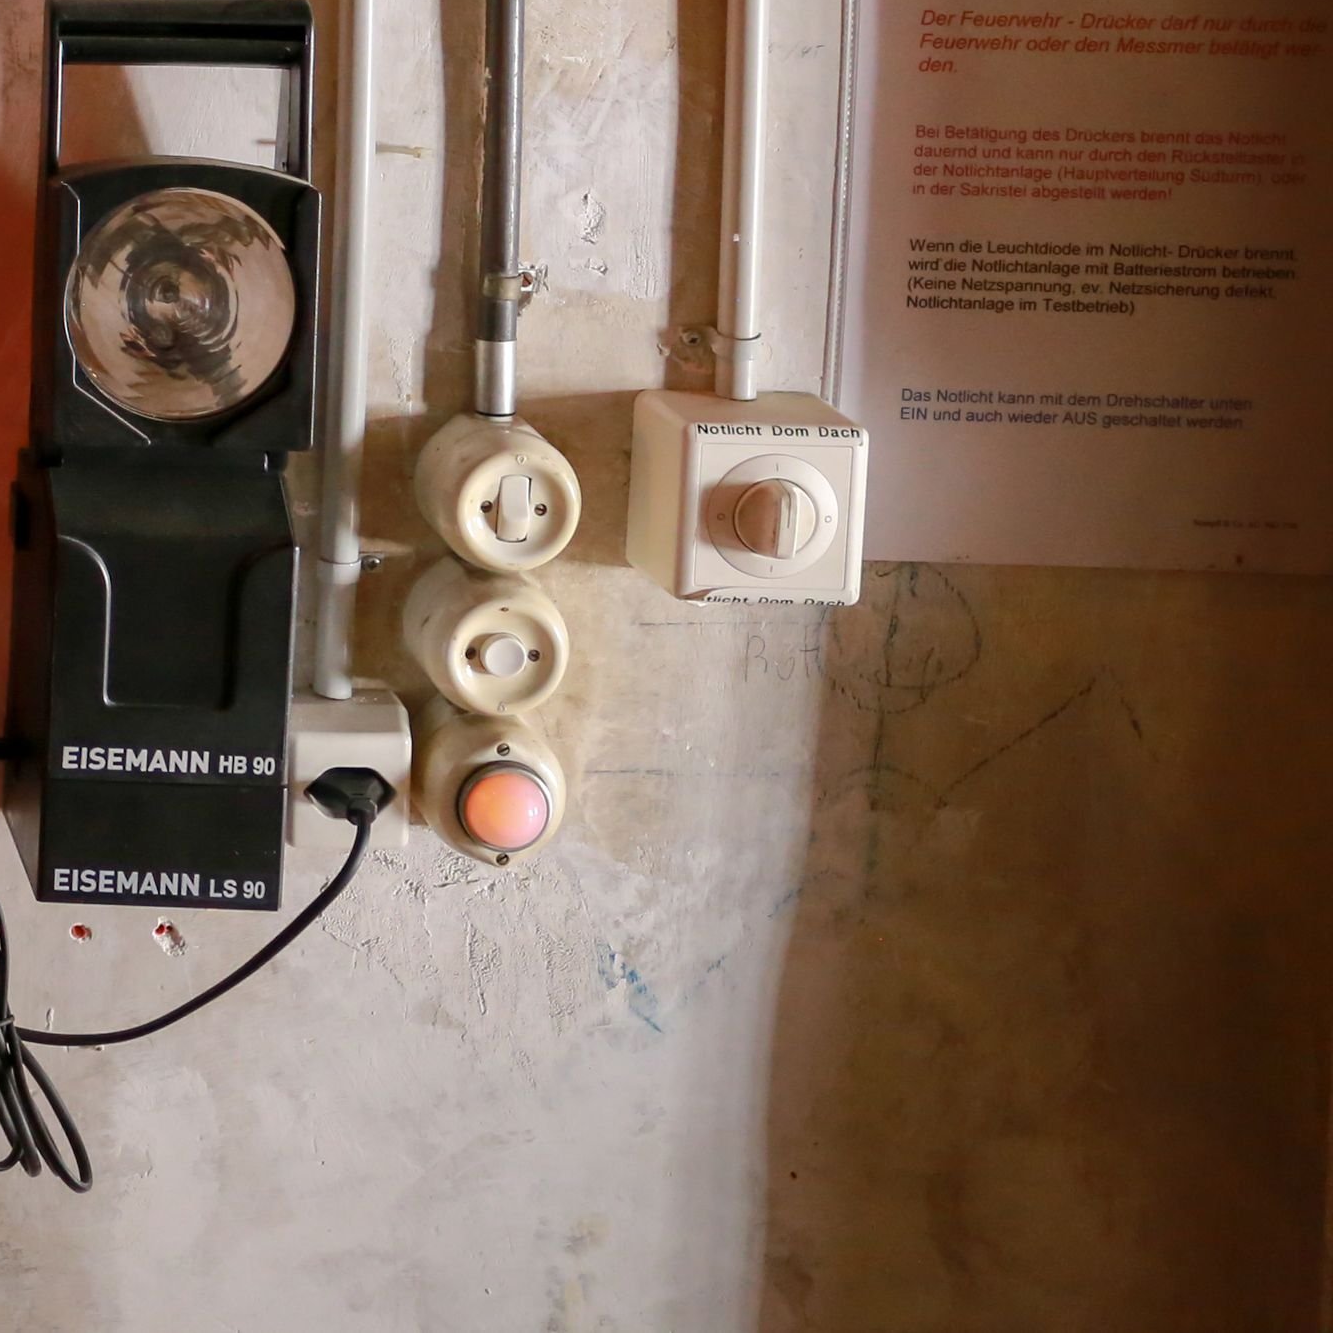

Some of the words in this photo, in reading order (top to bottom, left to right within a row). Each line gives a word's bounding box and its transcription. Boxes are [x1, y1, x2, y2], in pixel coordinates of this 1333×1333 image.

[921, 9, 957, 26] Der
[961, 11, 1062, 28] Feuerwehr
[1081, 12, 1154, 30] Drücker
[1161, 15, 1202, 31] darf
[1203, 19, 1233, 31] nur
[1238, 17, 1293, 33] durch
[920, 34, 1018, 51] Feuerwehr
[1027, 35, 1069, 52] oder
[1075, 36, 1109, 53] den
[1117, 37, 1205, 53] Messmer
[1208, 38, 1280, 59] betätigt
[919, 57, 957, 73] den.
[916, 125, 939, 139] Bei
[945, 126, 1027, 143] Betätigung
[1032, 129, 1061, 141] des
[1065, 128, 1135, 144] Drückers
[1140, 131, 1189, 144] brennt
[1195, 132, 1223, 144] das
[913, 145, 977, 158] dauernd
[982, 146, 1011, 159] und
[1016, 147, 1053, 160] kann
[1059, 149, 1083, 161] nur
[1088, 148, 1132, 162] durch
[1137, 150, 1166, 163] den
[913, 164, 938, 177] der
[943, 164, 1052, 182] Notlichtanlage
[1057, 166, 1184, 185] (Hauptverteilung
[930, 182, 955, 196] der
[959, 182, 1027, 197] Sakristei
[1031, 185, 1106, 202] abgestellt
[1110, 187, 1172, 201] werden!
[910, 238, 955, 253] Wenn
[959, 239, 983, 254] die
[987, 240, 1081, 256] Leuchtdiode
[1086, 243, 1104, 257] im
[1109, 243, 1173, 259] Notlicht-
[1178, 244, 1239, 259] Drücker
[909, 258, 938, 272] wird
[943, 258, 967, 273] die
[972, 260, 1081, 279] Notlichtanlage
[1085, 261, 1109, 276] mit
[1113, 262, 1216, 278] Batteriestrom
[907, 276, 957, 293] (Keine
[961, 278, 1076, 297] Netzspannung,
[1108, 281, 1220, 300] Netzsicherung
[906, 295, 1014, 312] Notlichtanlage
[1019, 297, 1037, 311] im
[1042, 298, 1135, 316] Testbetrieb)
[901, 387, 931, 402] Das
[936, 388, 994, 404] Notlicht
[998, 391, 1034, 405] kann
[1040, 392, 1063, 406] mit
[1067, 392, 1101, 407] dem
[1107, 393, 1204, 410] Drehschalter
[1209, 397, 1252, 411] unten
[900, 407, 927, 420] EIN
[933, 407, 961, 422] und
[965, 409, 1003, 423] auch
[1008, 410, 1058, 425] wieder
[1062, 411, 1097, 426] AUS
[1102, 412, 1181, 429] geschaltet
[697, 423, 762, 436] Notlicht
[772, 425, 809, 437] Dom
[818, 426, 861, 438] Dach
[62, 746, 210, 774] EISEMANN
[218, 755, 247, 774] HB
[252, 756, 276, 775] 90
[53, 868, 200, 897] EISEMANN
[209, 879, 238, 898] LS
[242, 880, 266, 899] 90
